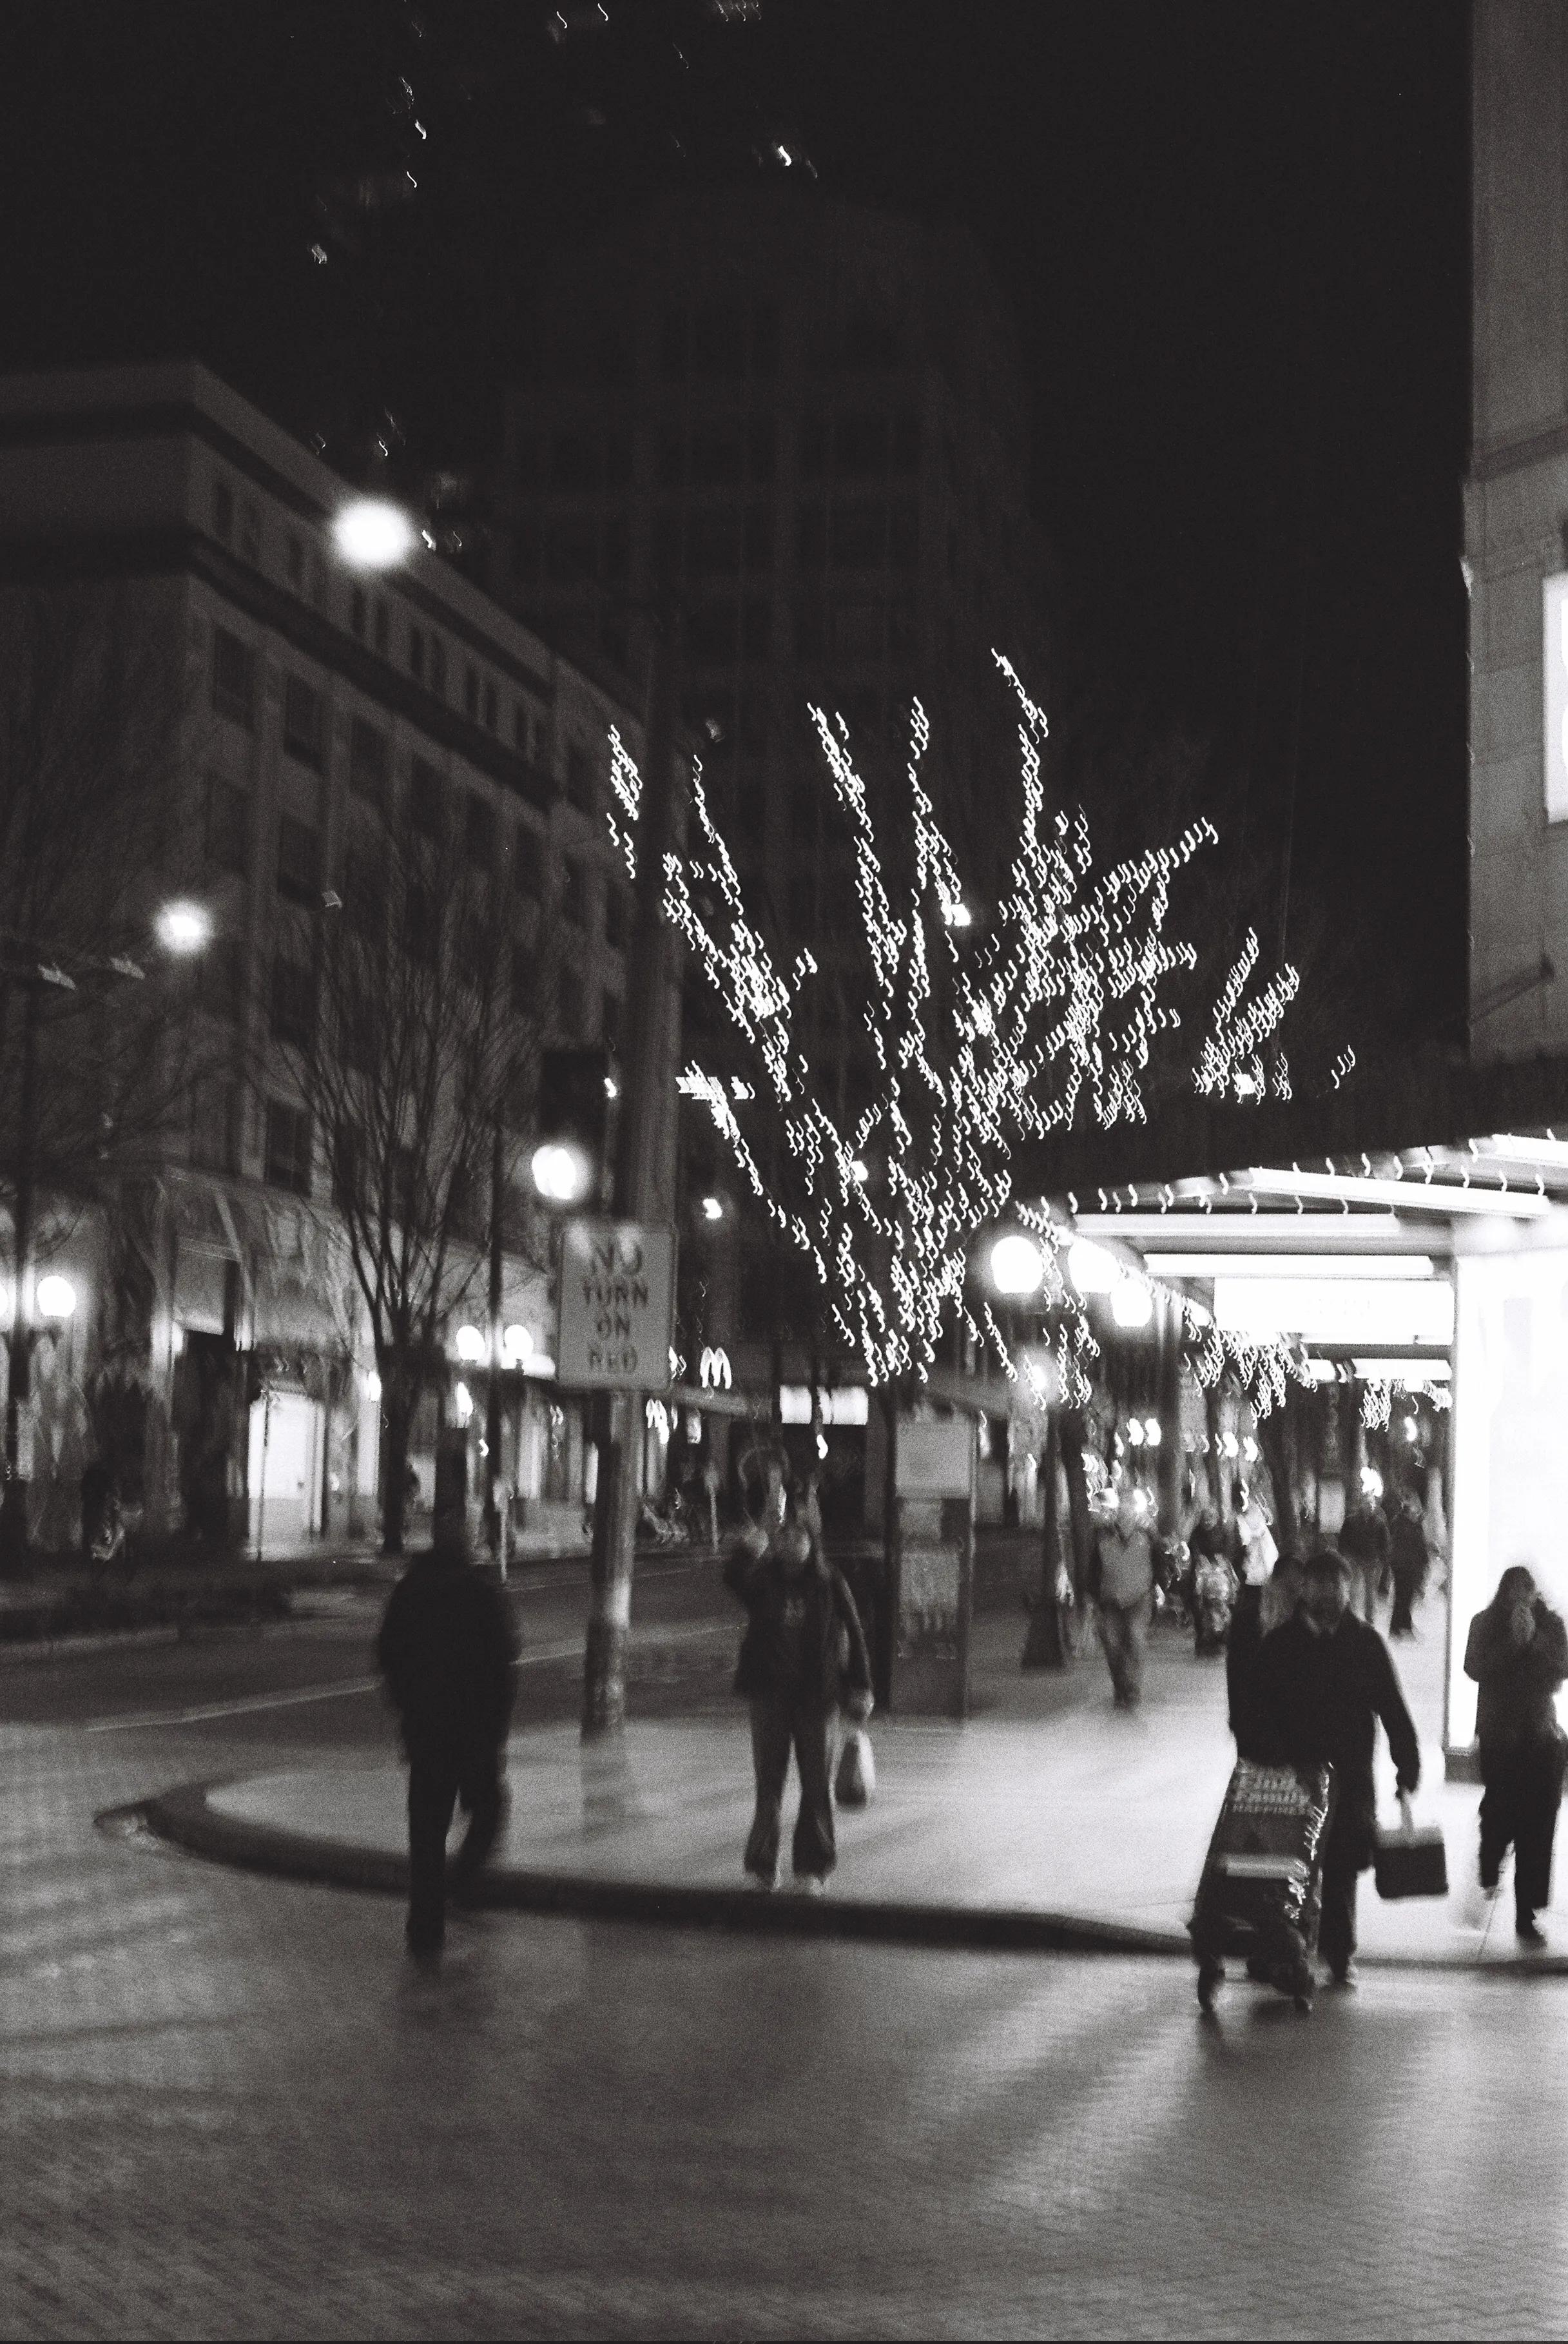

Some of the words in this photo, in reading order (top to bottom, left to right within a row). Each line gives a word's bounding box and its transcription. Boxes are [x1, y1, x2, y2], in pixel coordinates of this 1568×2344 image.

[591, 1239, 642, 1275] NO
[581, 1278, 648, 1309] TURN
[597, 1311, 630, 1340] ON
[588, 1345, 638, 1373] RED
